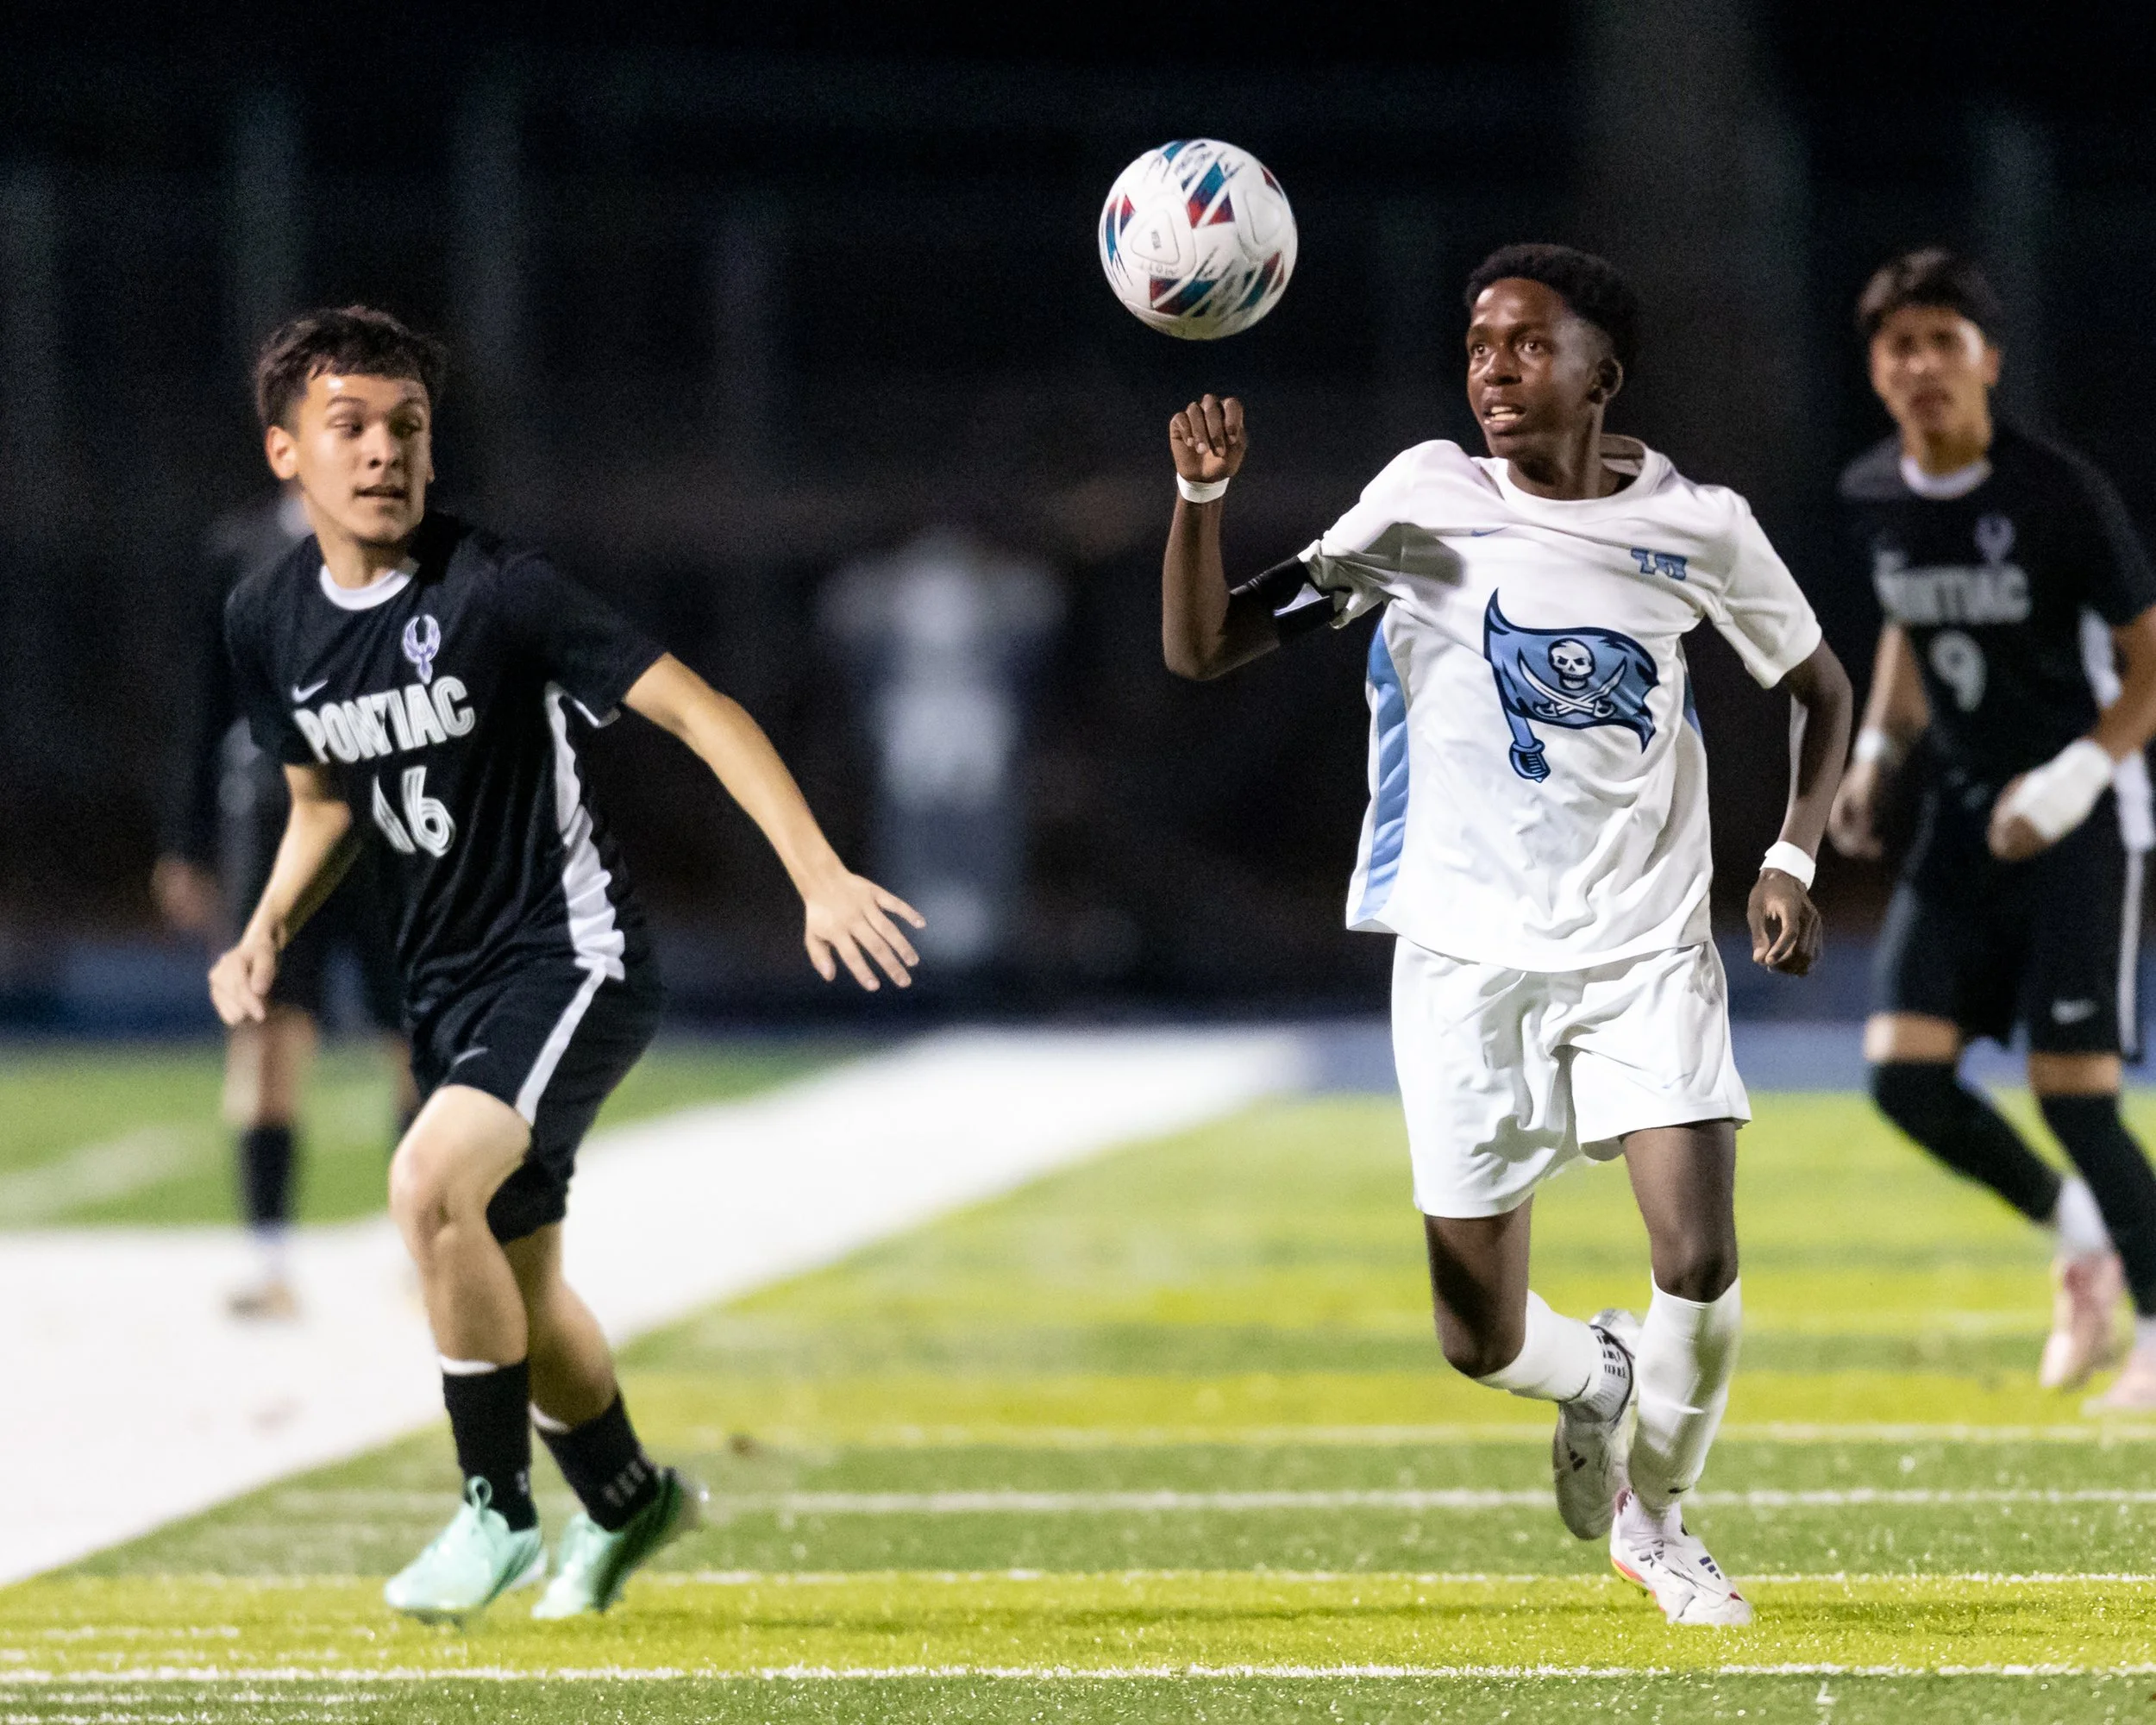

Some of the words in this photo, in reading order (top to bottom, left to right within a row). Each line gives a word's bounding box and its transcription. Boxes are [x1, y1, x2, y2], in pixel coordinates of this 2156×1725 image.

[1930, 630, 1986, 712] 9
[293, 676, 475, 764] PONTIAC
[373, 765, 456, 857] 16
